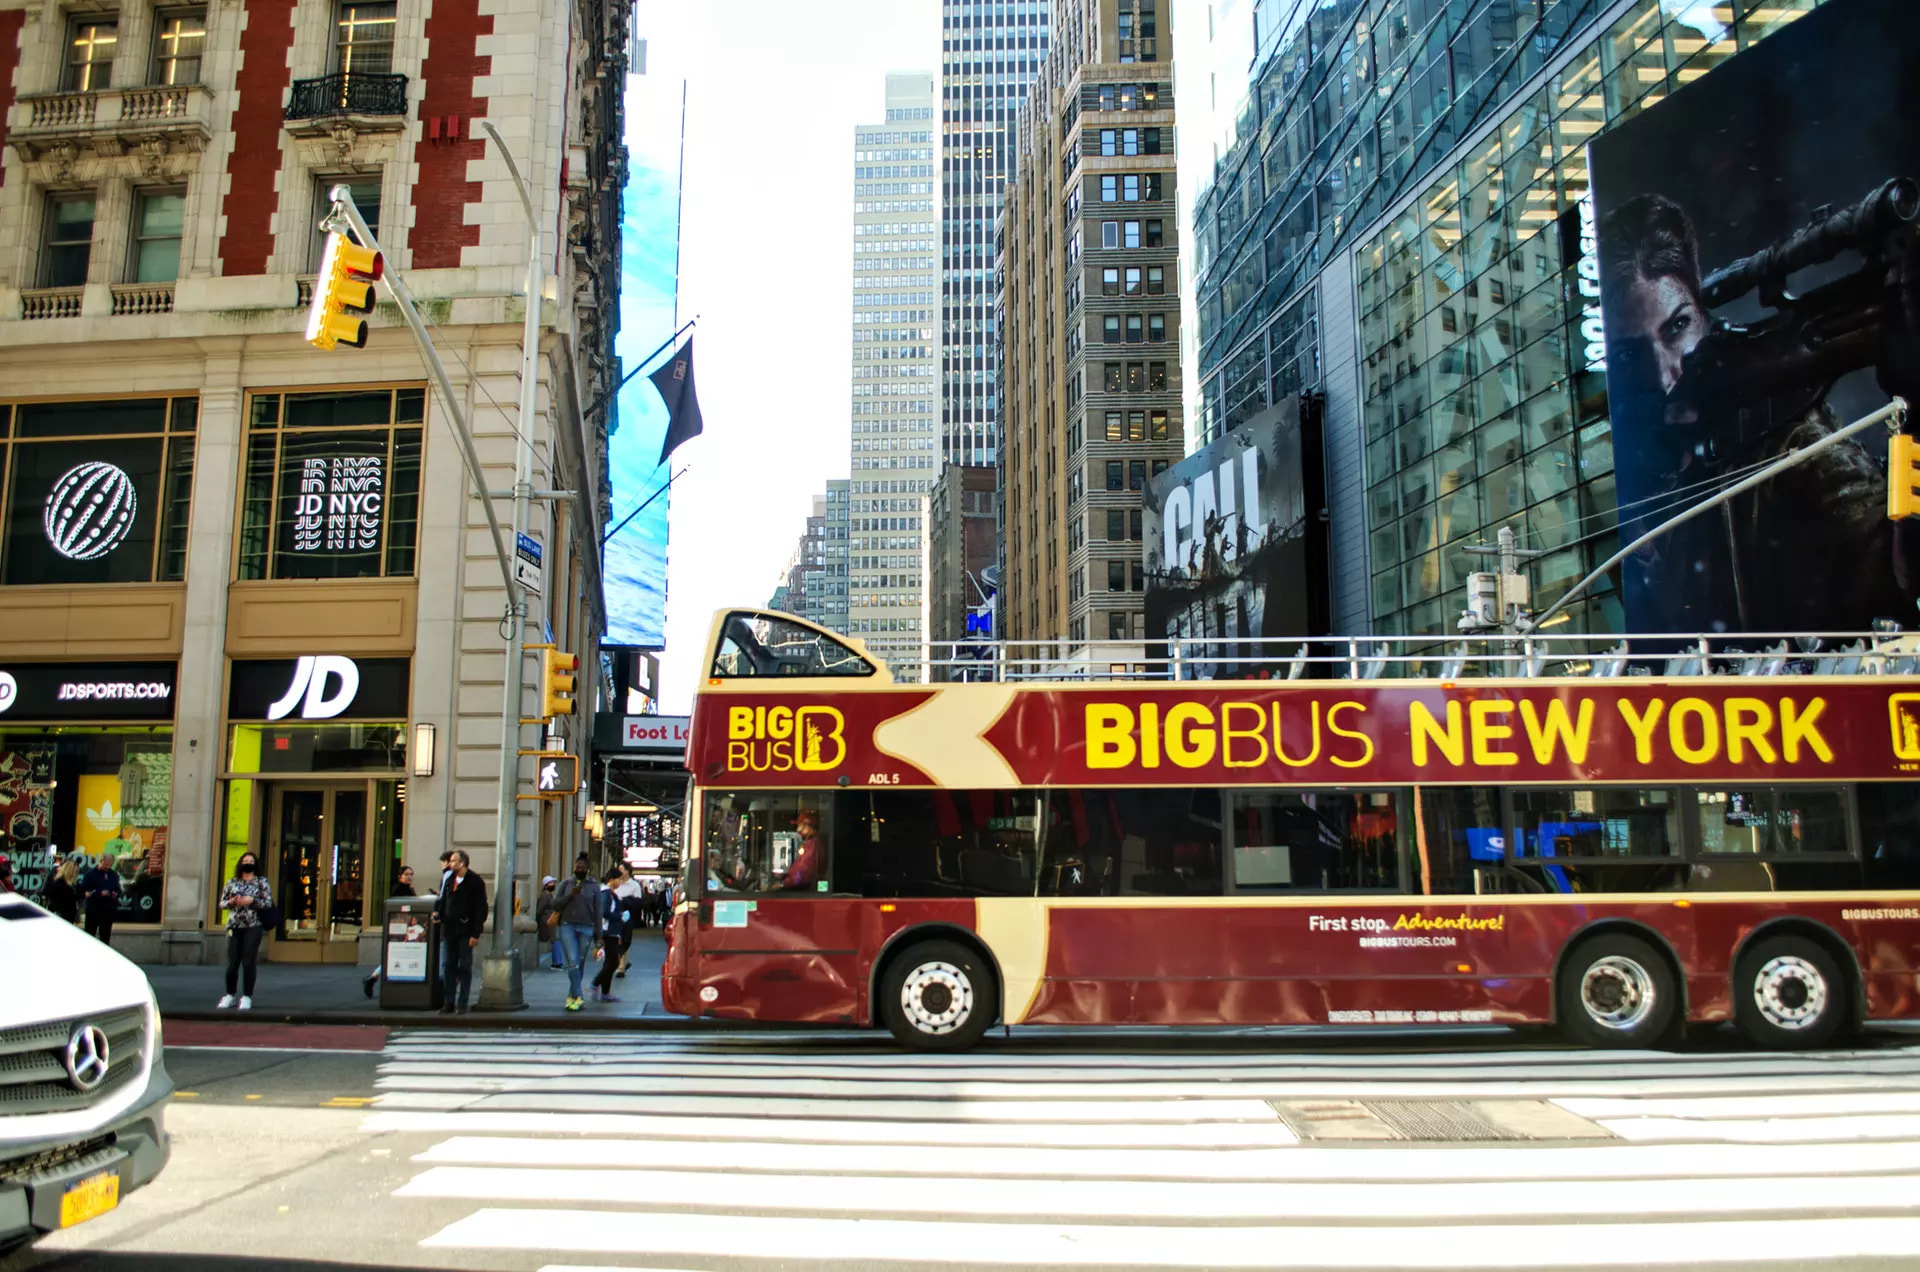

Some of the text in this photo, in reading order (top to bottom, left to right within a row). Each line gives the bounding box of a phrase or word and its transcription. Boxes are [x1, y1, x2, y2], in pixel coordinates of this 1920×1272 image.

[295, 493, 380, 515] JD NYC
[267, 656, 360, 720] JD
[629, 725, 667, 740] Foot
[728, 706, 794, 740] BIG
[1409, 698, 1595, 767] NEW
[1617, 697, 1835, 765] YORK
[728, 741, 793, 771] BUS
[868, 774, 900, 784] ADL 5
[1309, 912, 1504, 933] First stop. Adventure!
[1359, 937, 1456, 948] BIGBUSTOURS.COM
